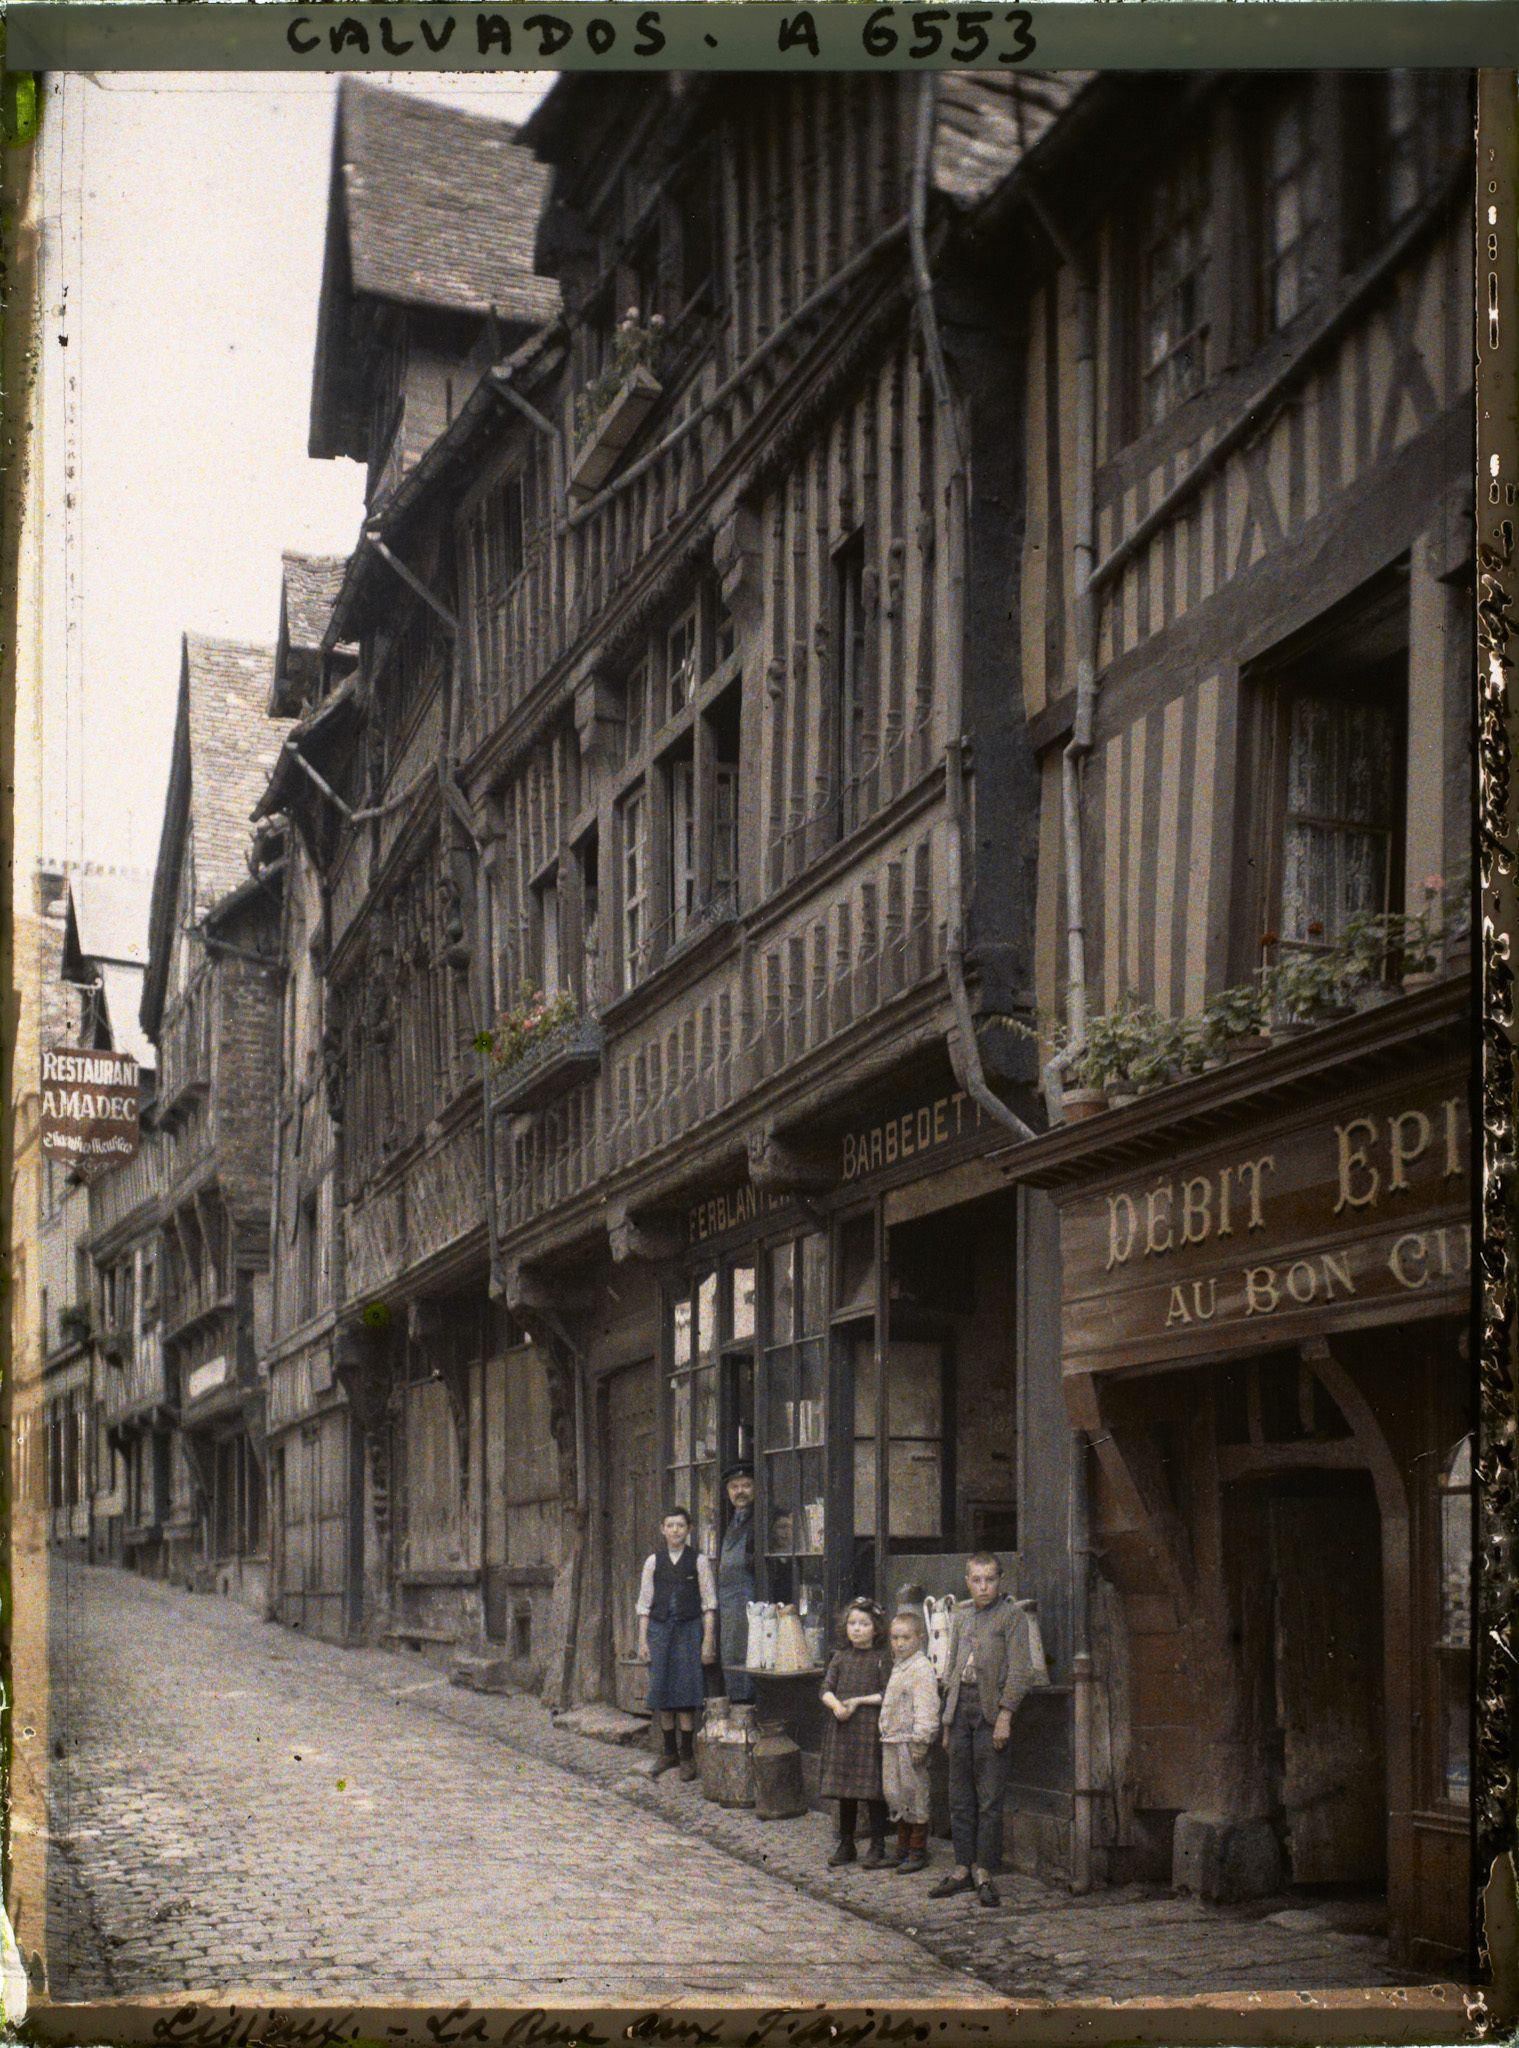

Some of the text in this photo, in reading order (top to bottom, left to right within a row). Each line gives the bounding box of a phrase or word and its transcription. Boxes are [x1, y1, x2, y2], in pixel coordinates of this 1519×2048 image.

[778, 10, 821, 58] A
[861, 6, 1037, 64] 6553
[42, 1051, 140, 1087] RESTAURANT
[42, 1089, 136, 1121] AMADEC
[1105, 1154, 1277, 1272] DÉBIT
[1165, 1278, 1217, 1328] AU
[1243, 1250, 1357, 1317] BON
